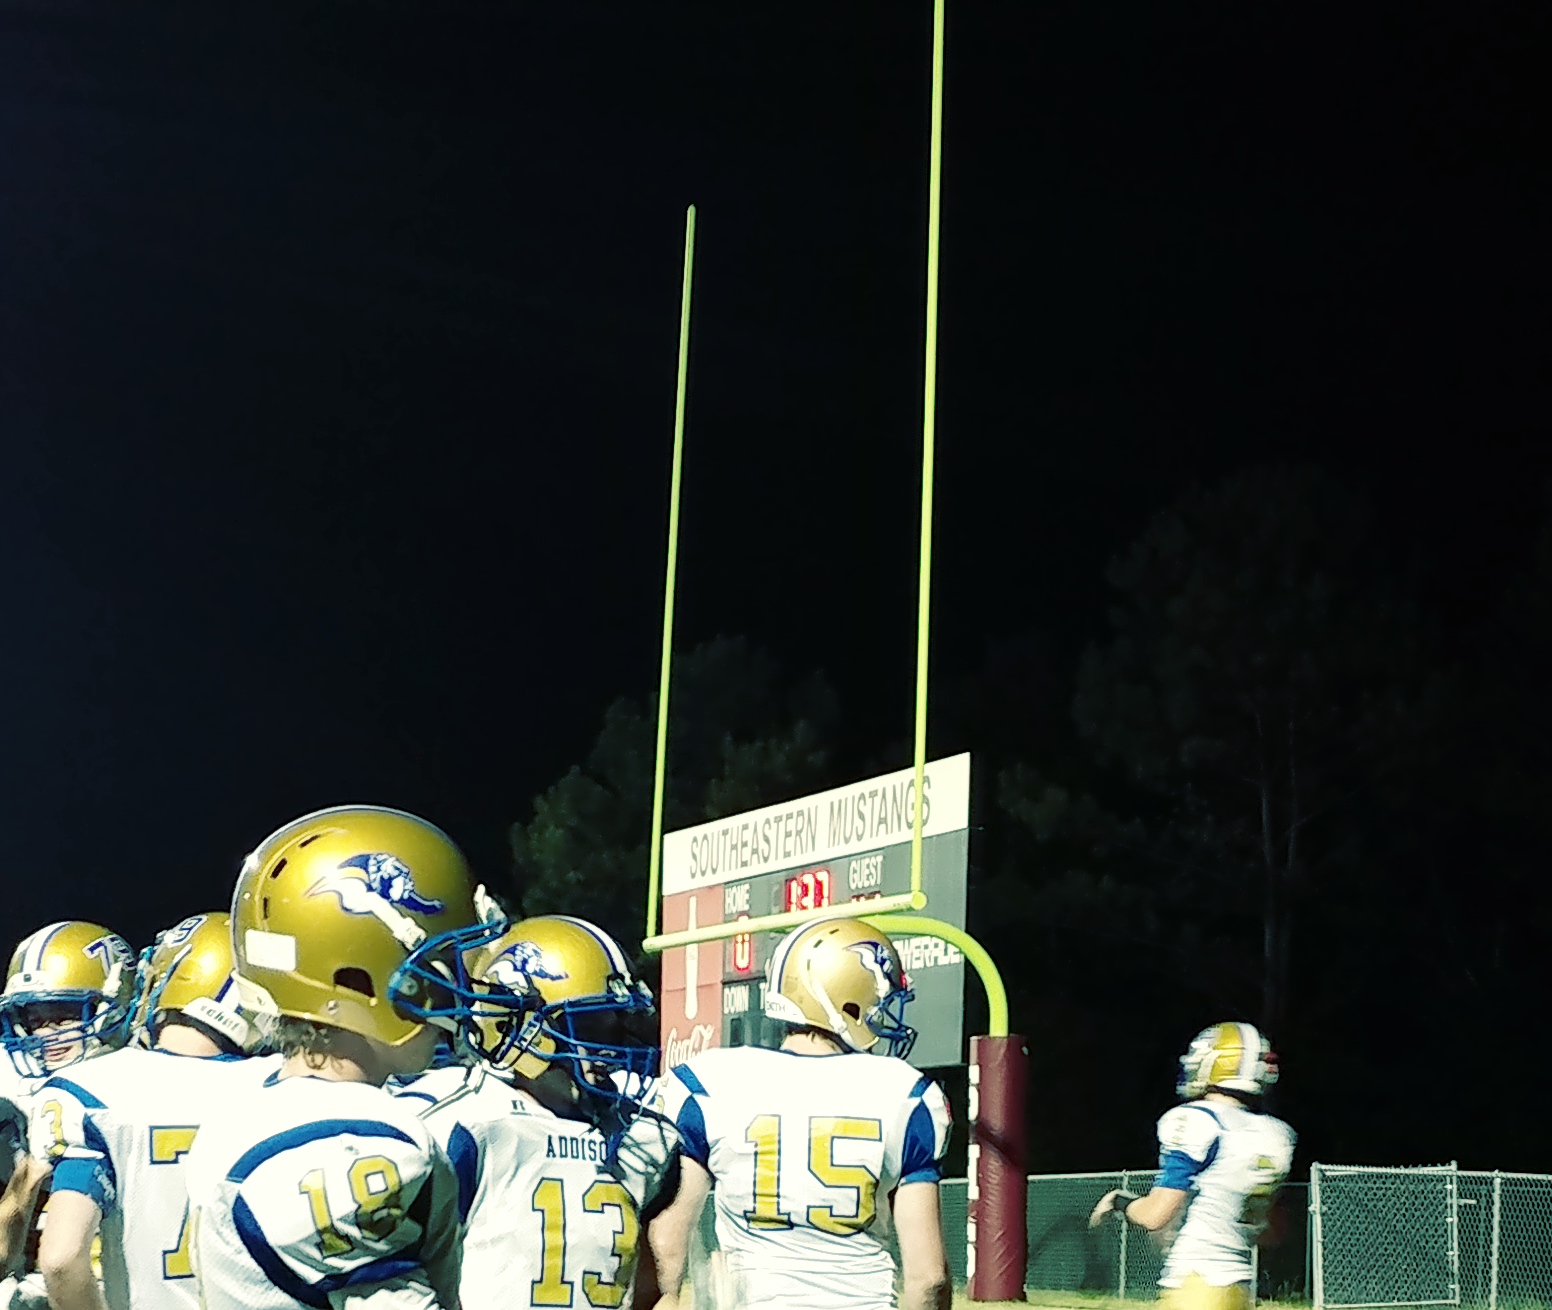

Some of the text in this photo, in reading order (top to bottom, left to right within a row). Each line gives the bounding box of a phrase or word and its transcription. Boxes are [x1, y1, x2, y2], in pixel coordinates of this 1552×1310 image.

[690, 806, 819, 880] SOUTHEASTERN
[725, 883, 751, 914] HOME
[849, 854, 884, 889] GUEST
[723, 981, 749, 1014] DOWN
[545, 1134, 609, 1165] ADDISO
[743, 1113, 883, 1239] 15
[297, 1154, 405, 1259] 18
[529, 1176, 640, 1310] 13
